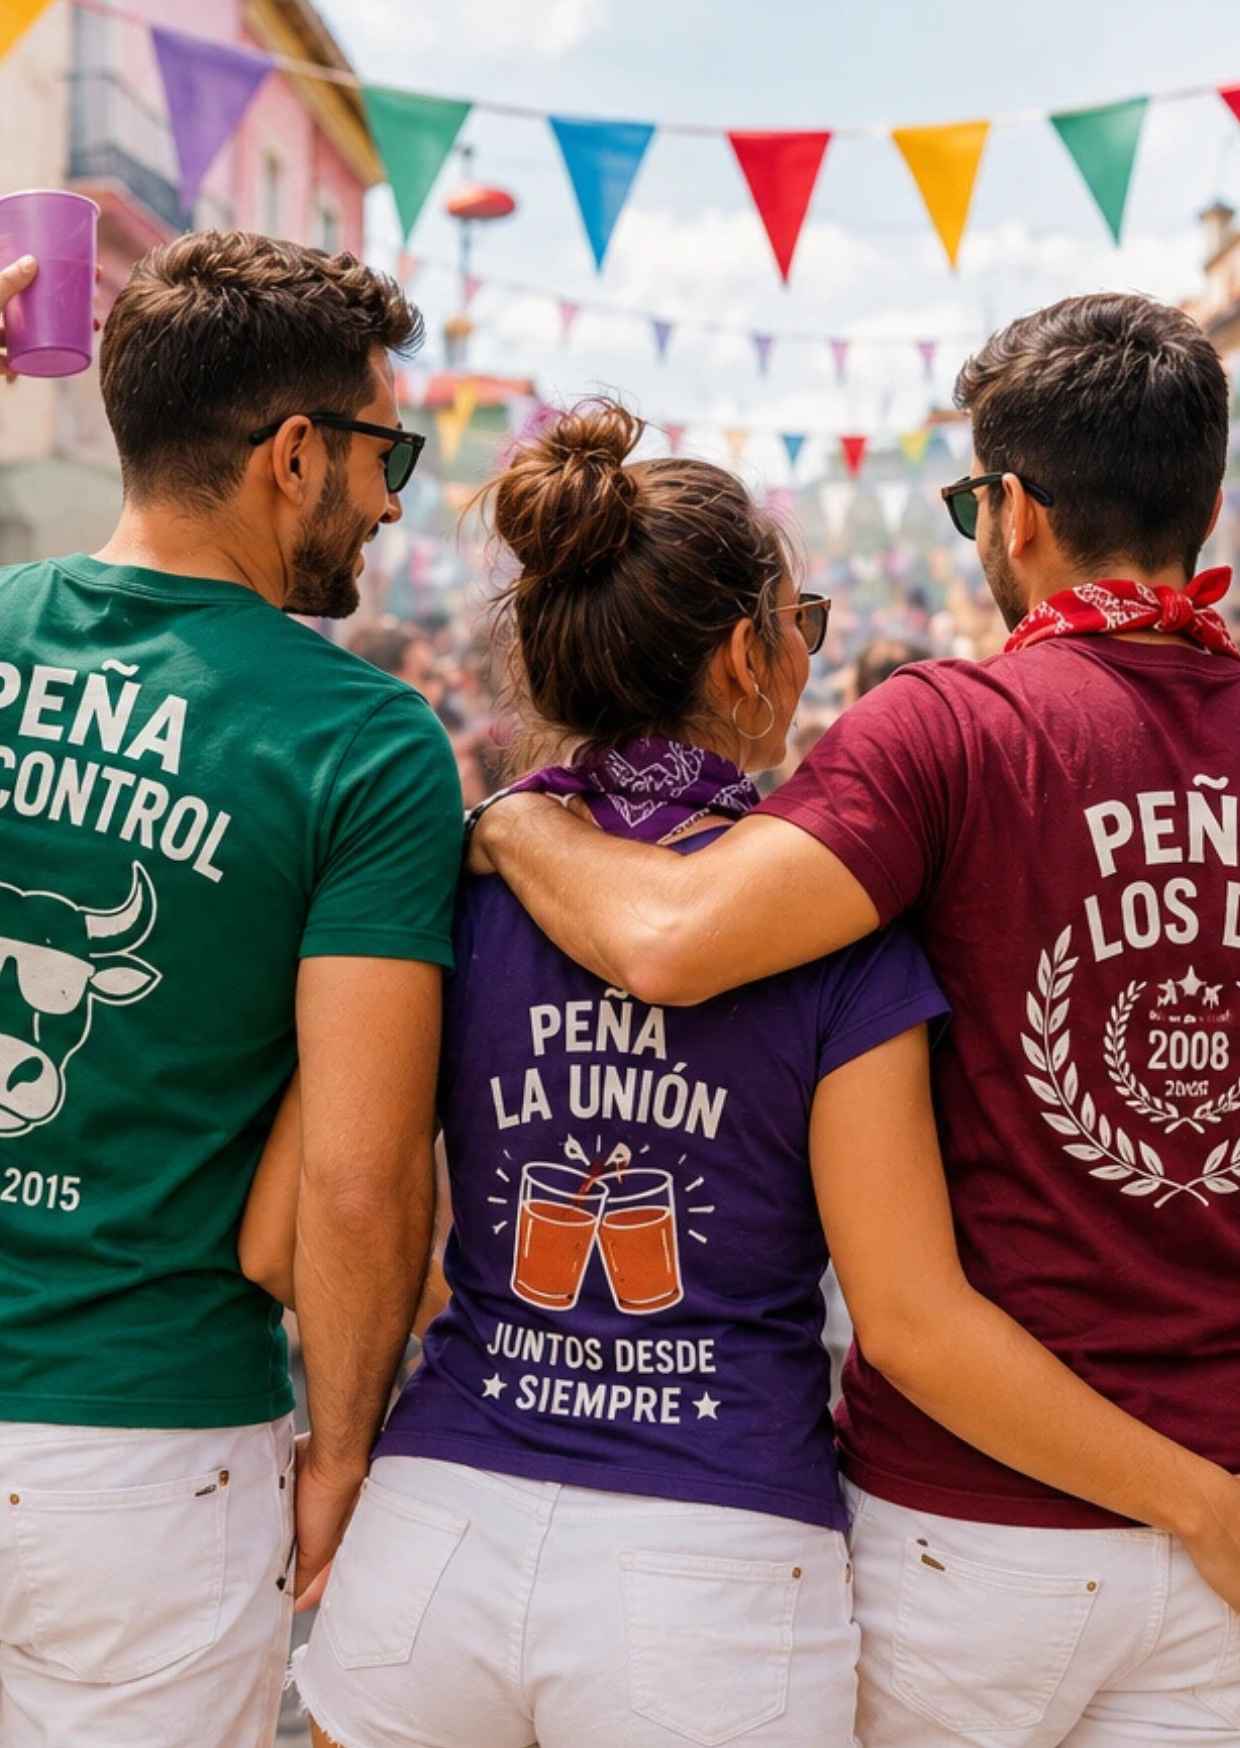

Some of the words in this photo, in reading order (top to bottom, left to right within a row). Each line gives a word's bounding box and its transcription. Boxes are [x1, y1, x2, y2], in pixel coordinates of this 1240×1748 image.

[1084, 877, 1199, 962] LOS
[529, 987, 666, 1060] PEÑA
[1147, 1029, 1229, 1071] 2008
[490, 1068, 553, 1130] LA
[570, 1062, 728, 1140] UNIÓN
[0, 1167, 81, 1212] 2015
[487, 1322, 603, 1371] JUNTOS
[616, 1339, 716, 1373] DESDE
[515, 1374, 681, 1424] SIEMPRE
